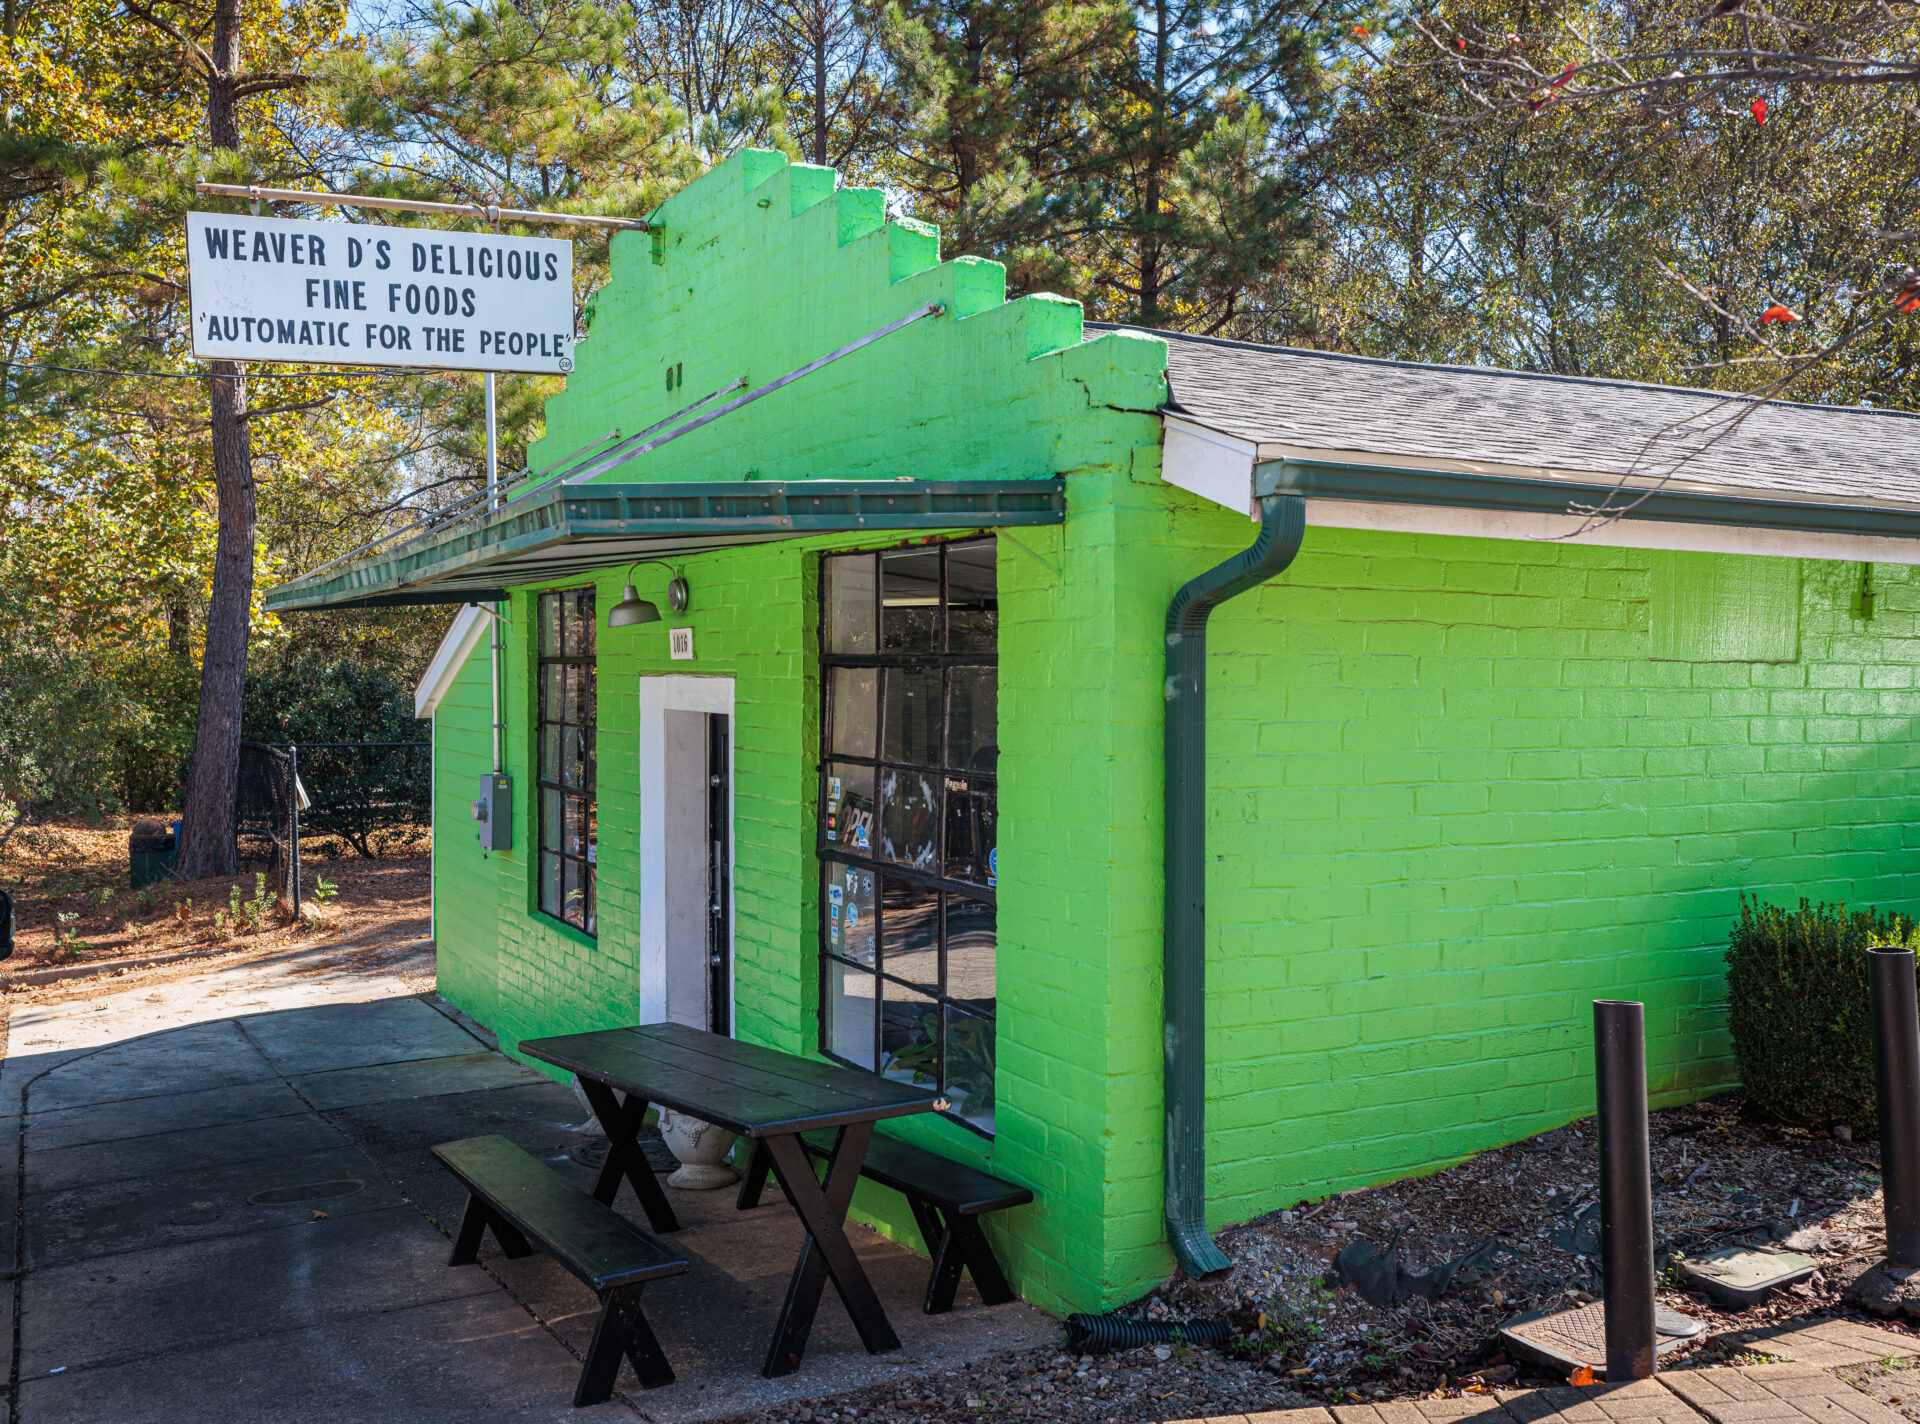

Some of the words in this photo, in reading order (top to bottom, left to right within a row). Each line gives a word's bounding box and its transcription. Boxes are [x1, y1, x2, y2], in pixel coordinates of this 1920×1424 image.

[204, 227, 326, 266] WEAVER
[348, 237, 391, 270] D'S
[412, 242, 558, 281] DELICIOUS
[305, 278, 367, 310] FINE
[388, 283, 476, 317] FOODS
[199, 312, 350, 347] "AUTOMATIC
[366, 323, 412, 351] FOR
[422, 326, 465, 353] THE
[479, 331, 572, 358] PEOPLE"
[673, 632, 688, 653] 1016
